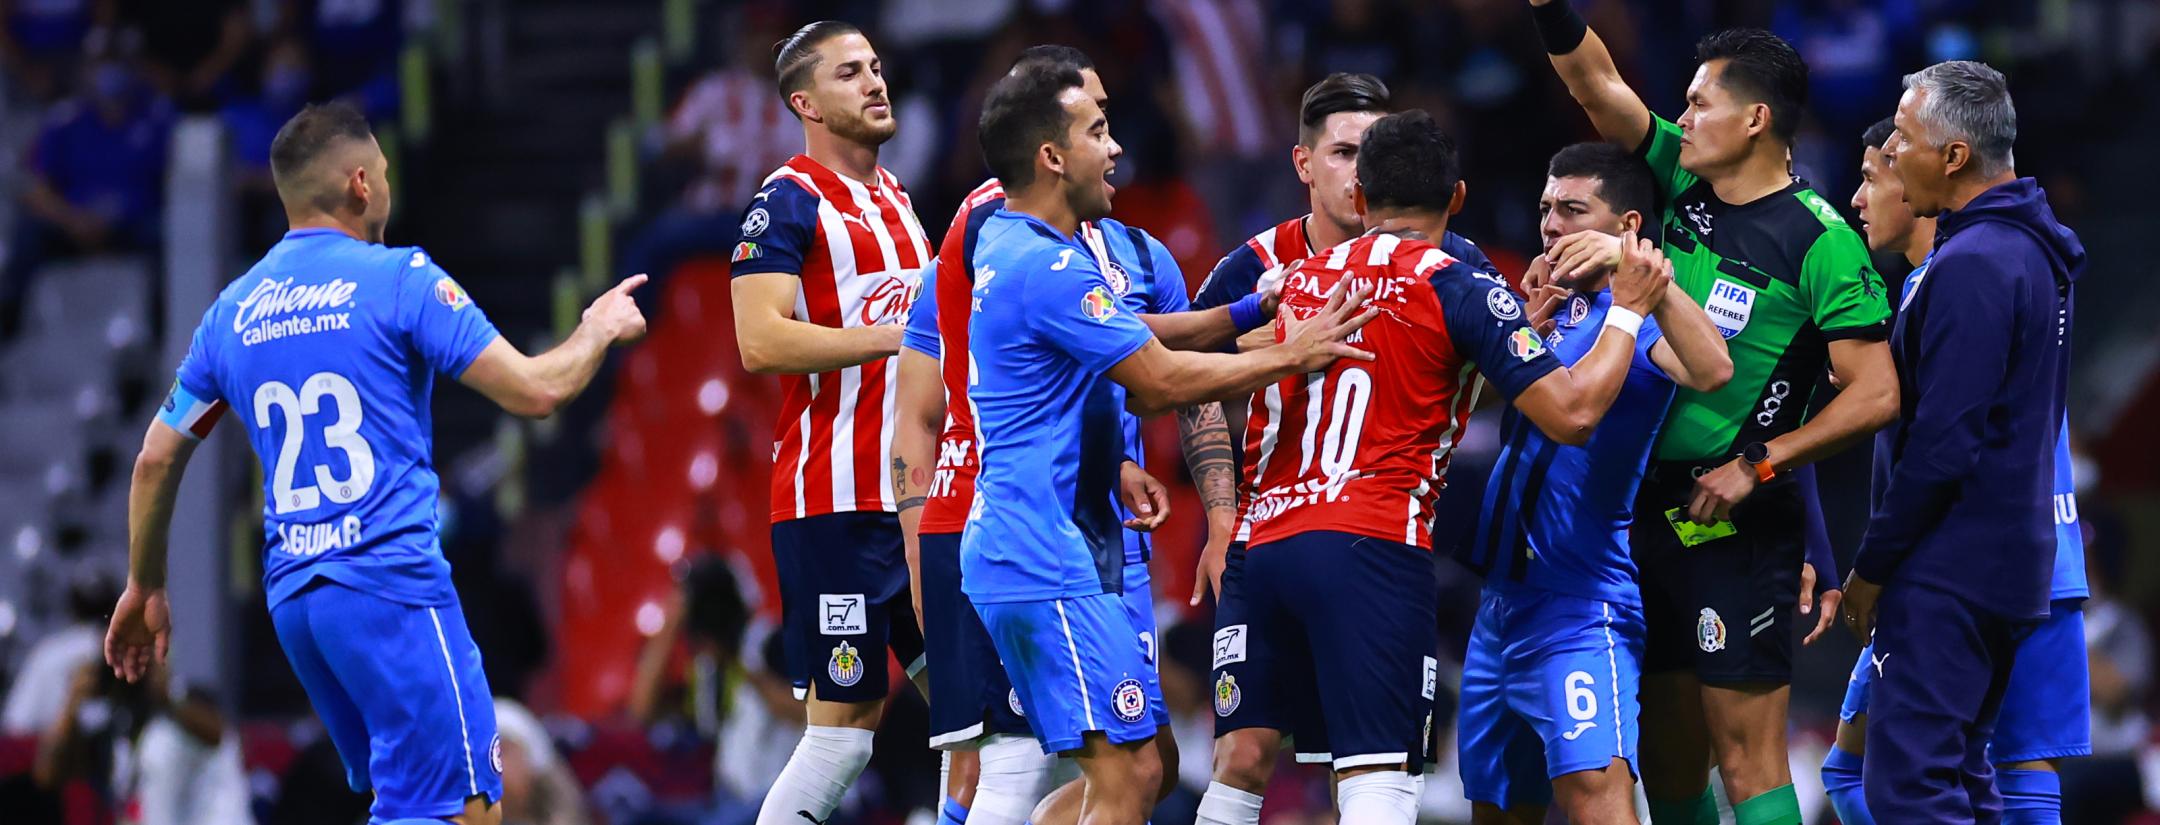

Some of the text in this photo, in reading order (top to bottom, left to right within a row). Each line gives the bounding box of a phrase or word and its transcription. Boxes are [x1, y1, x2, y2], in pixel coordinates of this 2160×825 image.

[233, 276, 357, 333] Caliente
[1708, 304, 1745, 322] REFEREE
[1714, 282, 1748, 305] FIFA
[242, 312, 351, 347] caliente.mx
[254, 371, 376, 515] 23
[1297, 367, 1373, 484] 10
[1564, 670, 1598, 721] 6
